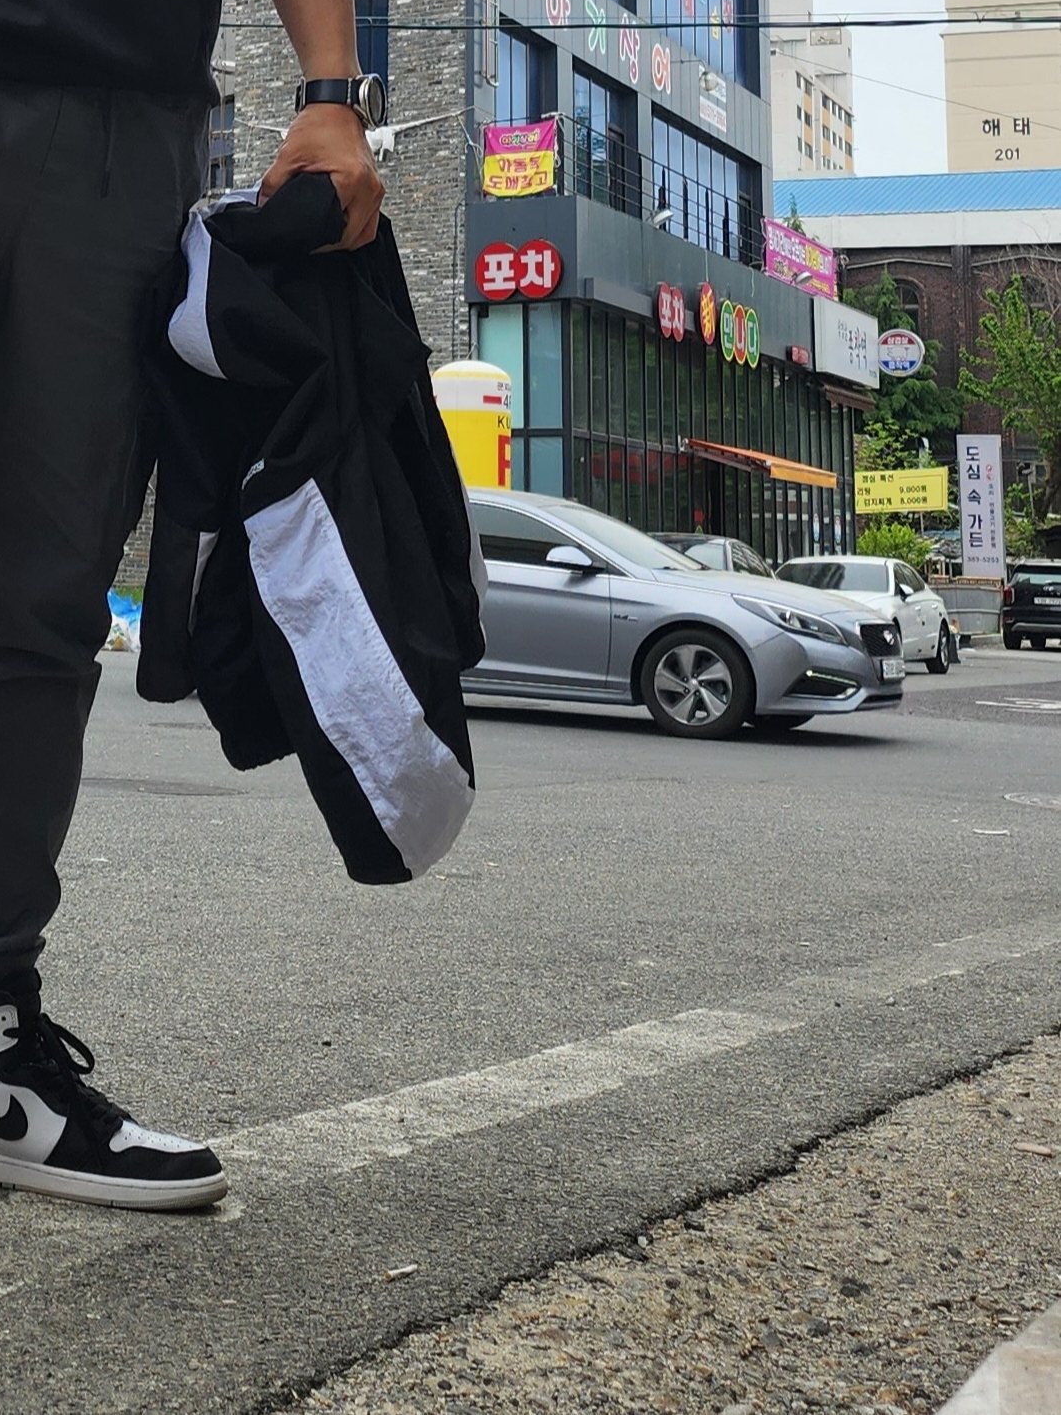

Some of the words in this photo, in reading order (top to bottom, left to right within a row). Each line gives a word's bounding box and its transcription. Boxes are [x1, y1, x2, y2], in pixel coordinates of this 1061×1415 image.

[994, 147, 1021, 162] 201
[483, 249, 555, 292] 포차
[659, 291, 684, 334] 포차
[965, 445, 981, 481] 도심
[966, 488, 982, 505] 속
[967, 513, 984, 549] 가든
